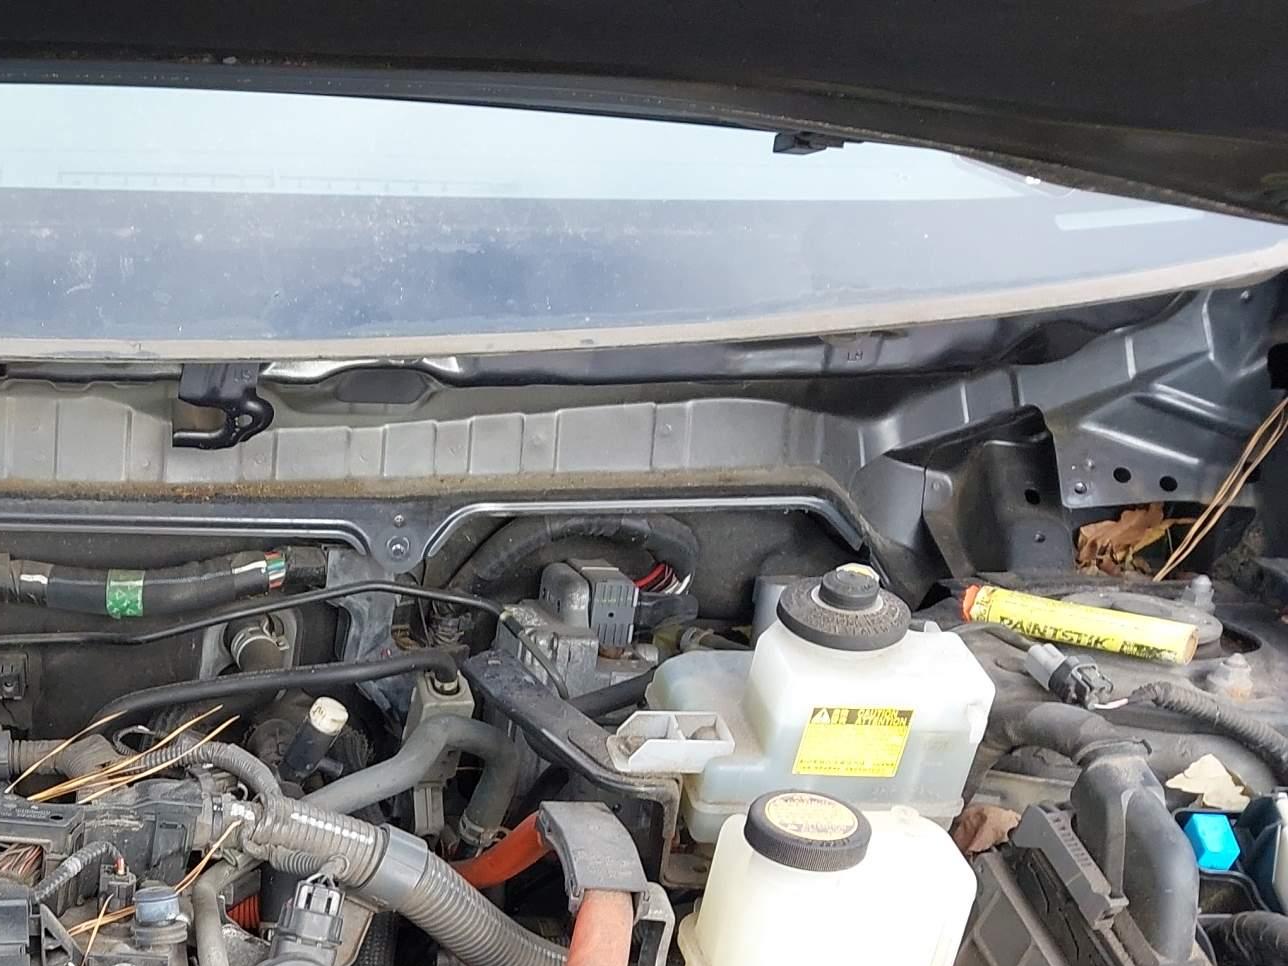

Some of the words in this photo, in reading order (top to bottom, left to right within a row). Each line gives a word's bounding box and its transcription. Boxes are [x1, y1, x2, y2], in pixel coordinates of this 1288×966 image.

[999, 615, 1114, 650] PAINTSTIK
[857, 709, 899, 720] CAUTION
[855, 718, 908, 726] ATTENTION
